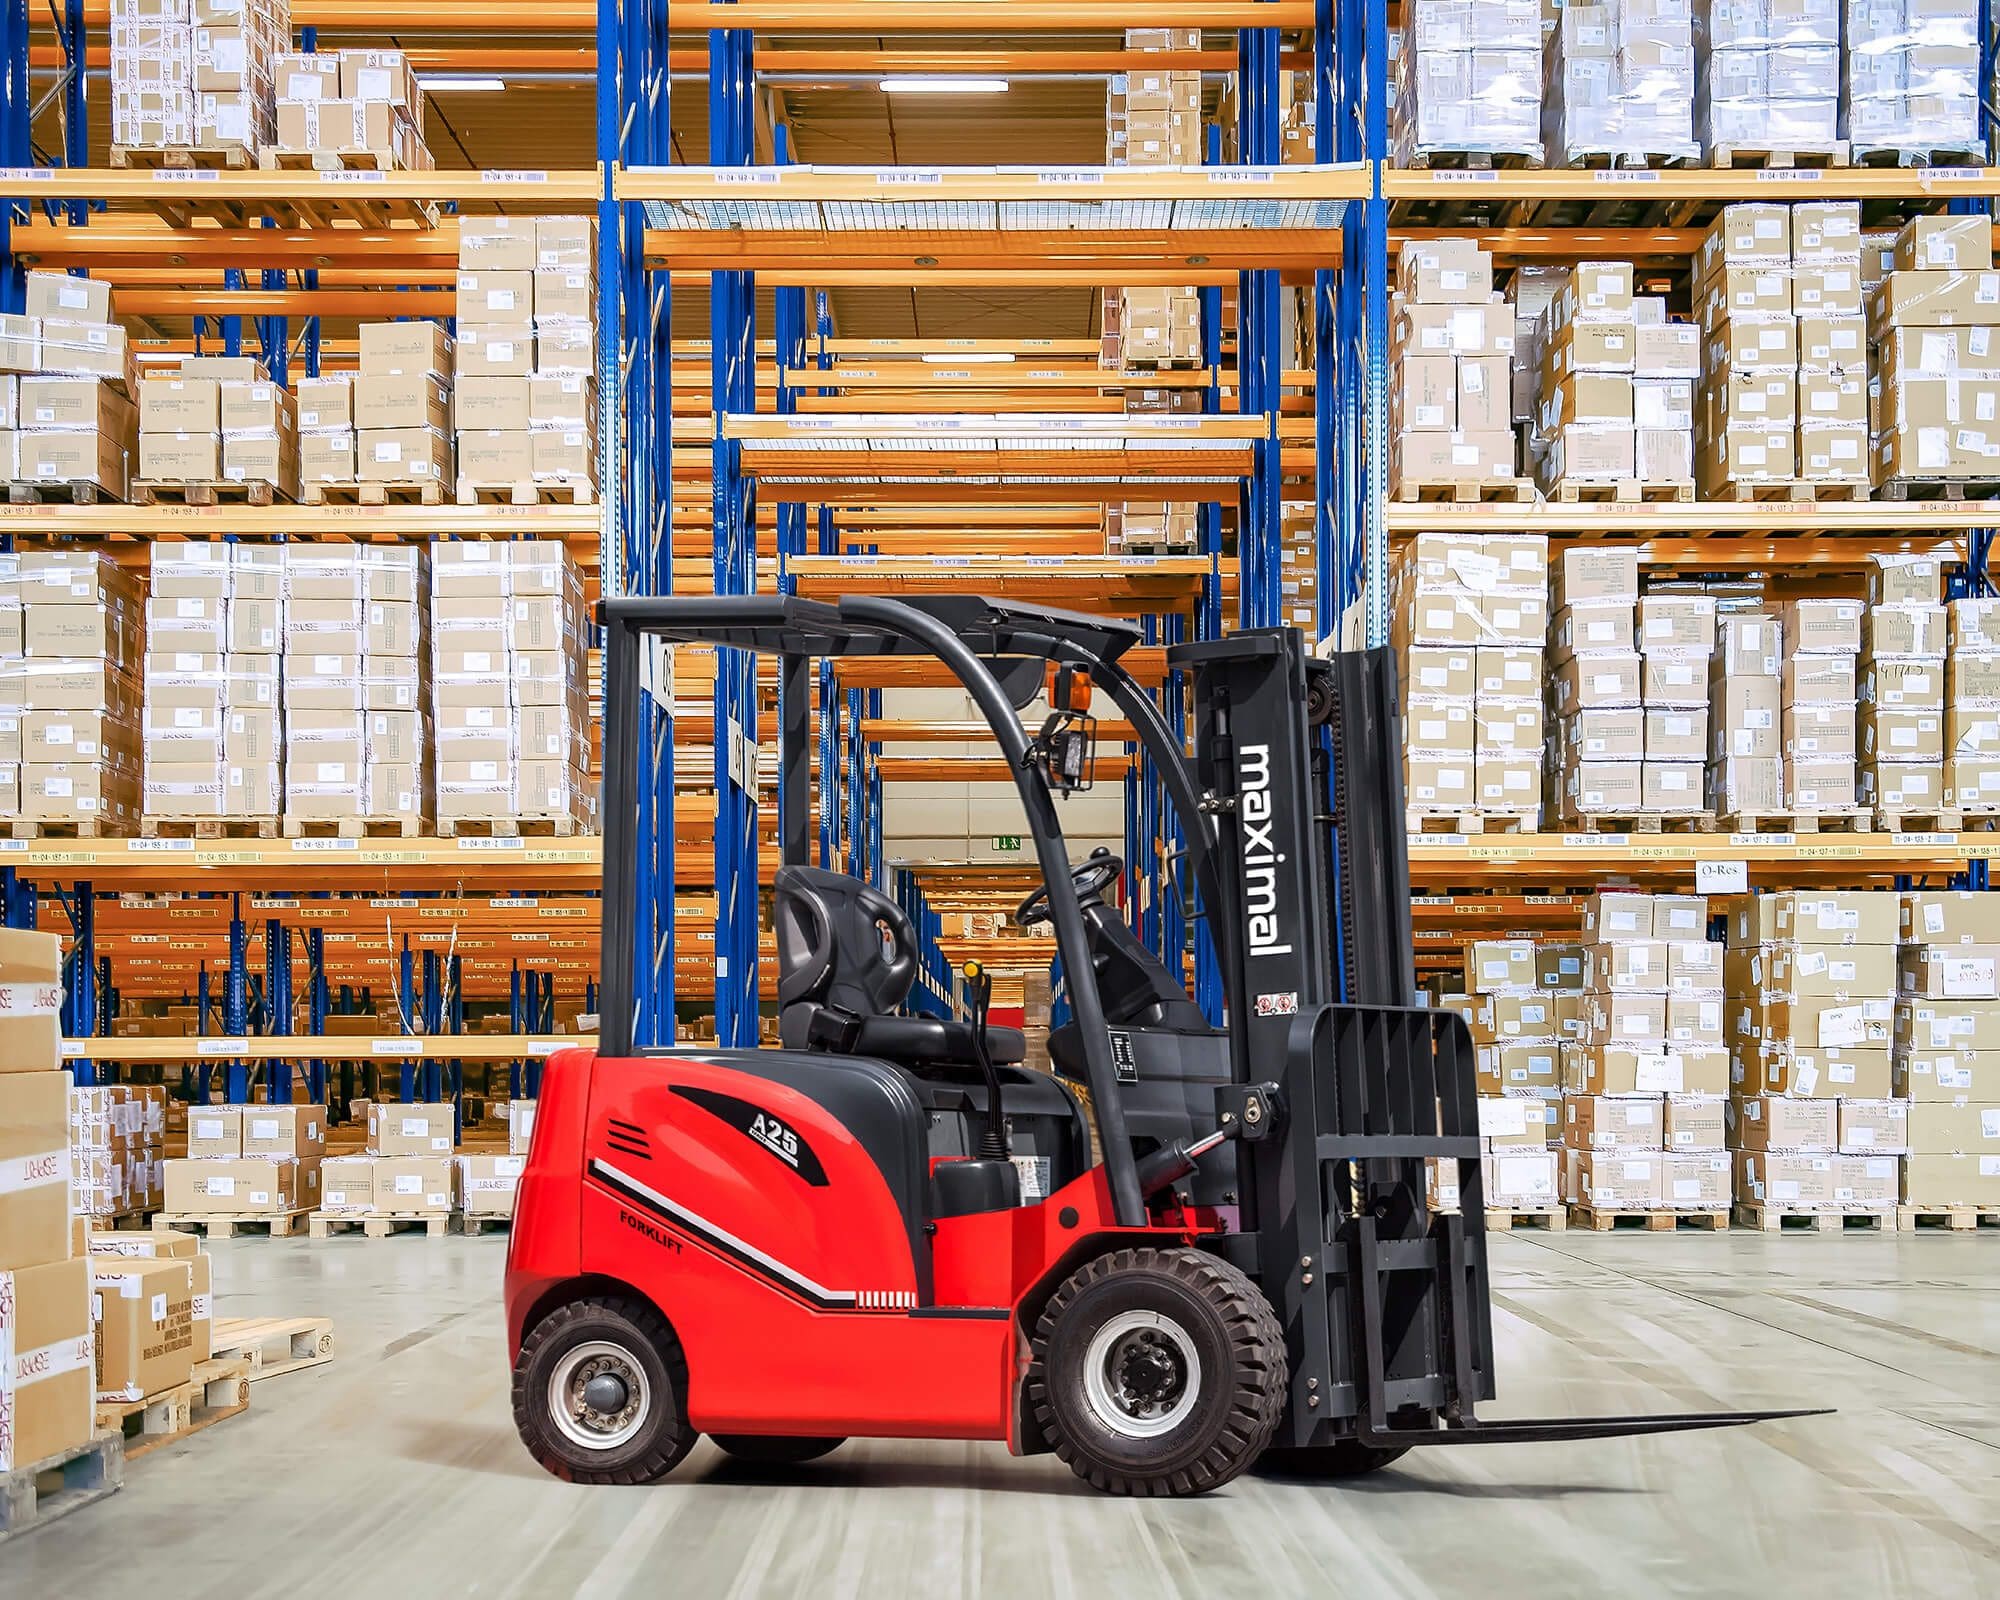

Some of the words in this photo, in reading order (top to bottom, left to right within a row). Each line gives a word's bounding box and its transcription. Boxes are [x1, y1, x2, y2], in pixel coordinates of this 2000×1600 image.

[1238, 743, 1293, 958] maximal
[752, 1113, 799, 1155] A25
[619, 1209, 684, 1256] FORKLIFT
